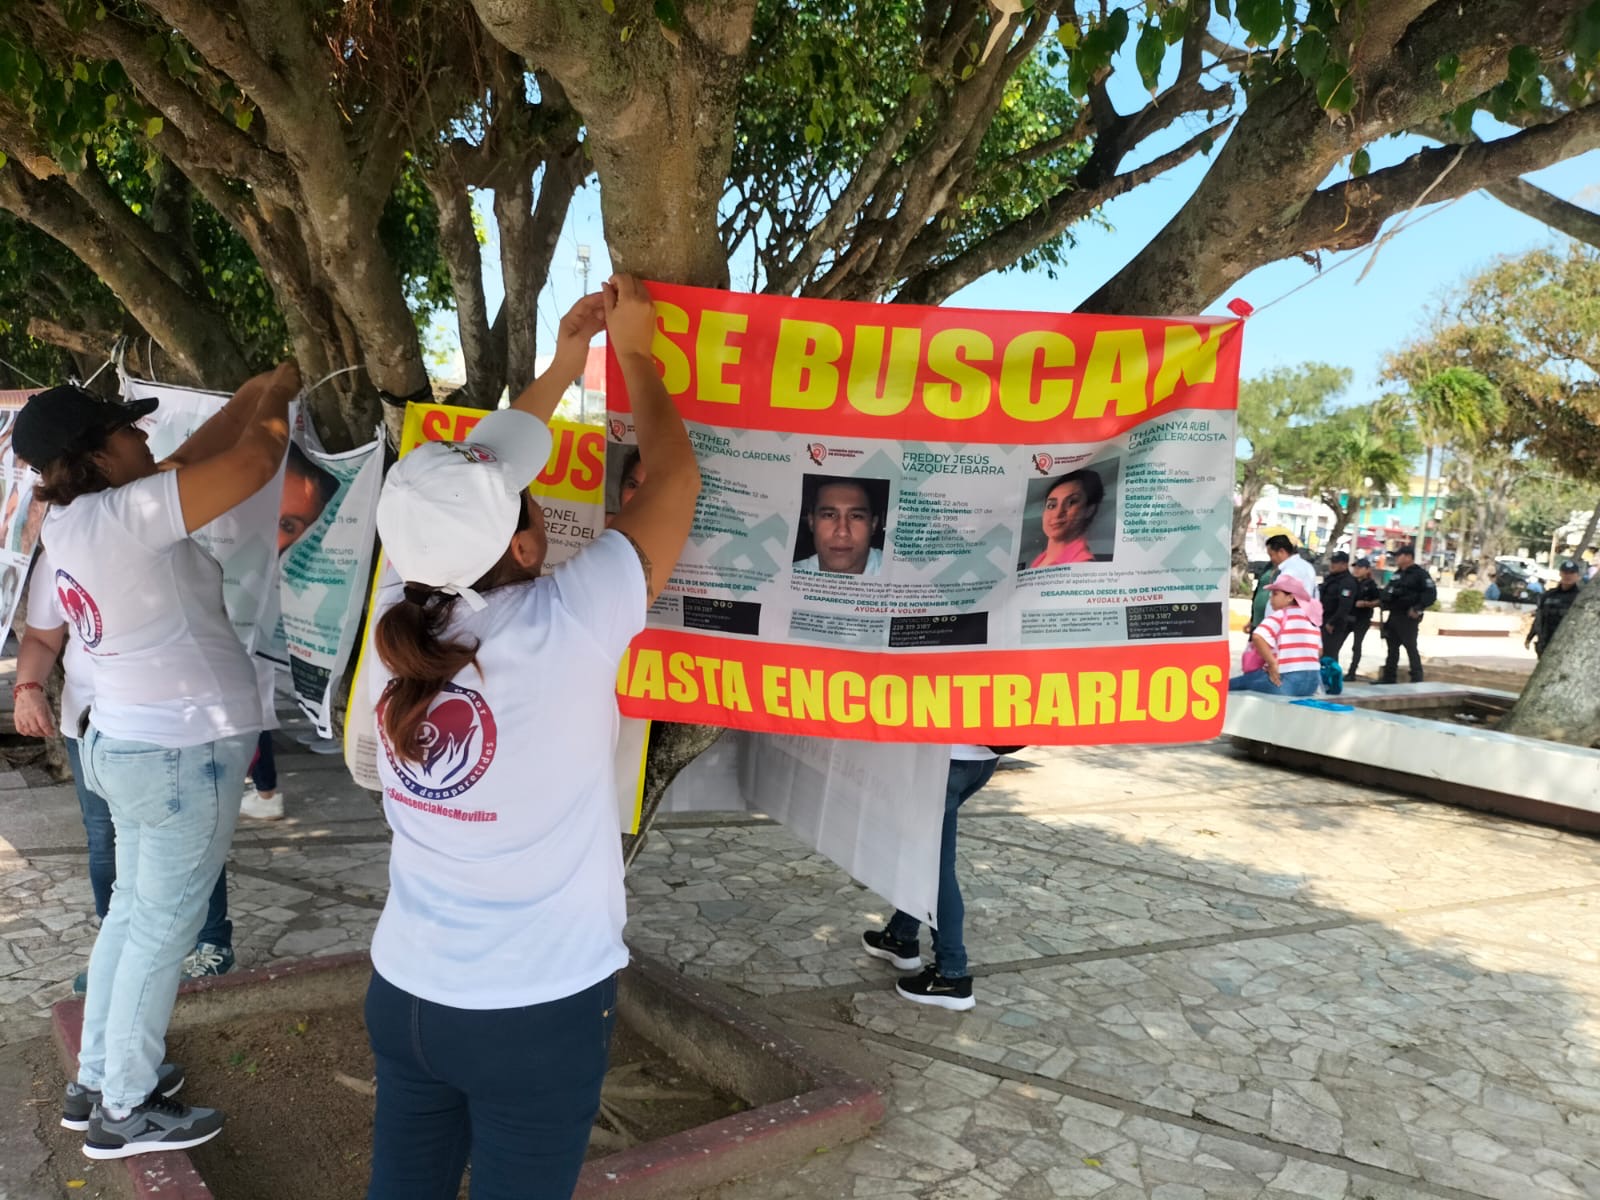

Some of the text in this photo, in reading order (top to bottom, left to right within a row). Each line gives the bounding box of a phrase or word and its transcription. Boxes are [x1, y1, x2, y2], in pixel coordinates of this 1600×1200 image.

[651, 301, 1239, 422] SE BUSCAN
[689, 430, 731, 447] ESTHER
[1129, 420, 1210, 442] ITHANNYA RUBÍ
[1128, 432, 1227, 450] CABALLERO ACOSTA
[536, 431, 604, 490] US
[742, 449, 791, 462] CÁRDENAS
[902, 452, 989, 465] FREDDY JESÚS
[961, 465, 1005, 475] IBARRA
[919, 490, 946, 498] hombre
[543, 507, 579, 522] ONEL
[544, 521, 567, 535] REZ
[804, 594, 856, 605] DESAPARECIDO
[1130, 594, 1164, 602] VOLVER
[762, 664, 1222, 728] ENCONTRARLOS
[420, 742, 494, 796] desaparecidos
